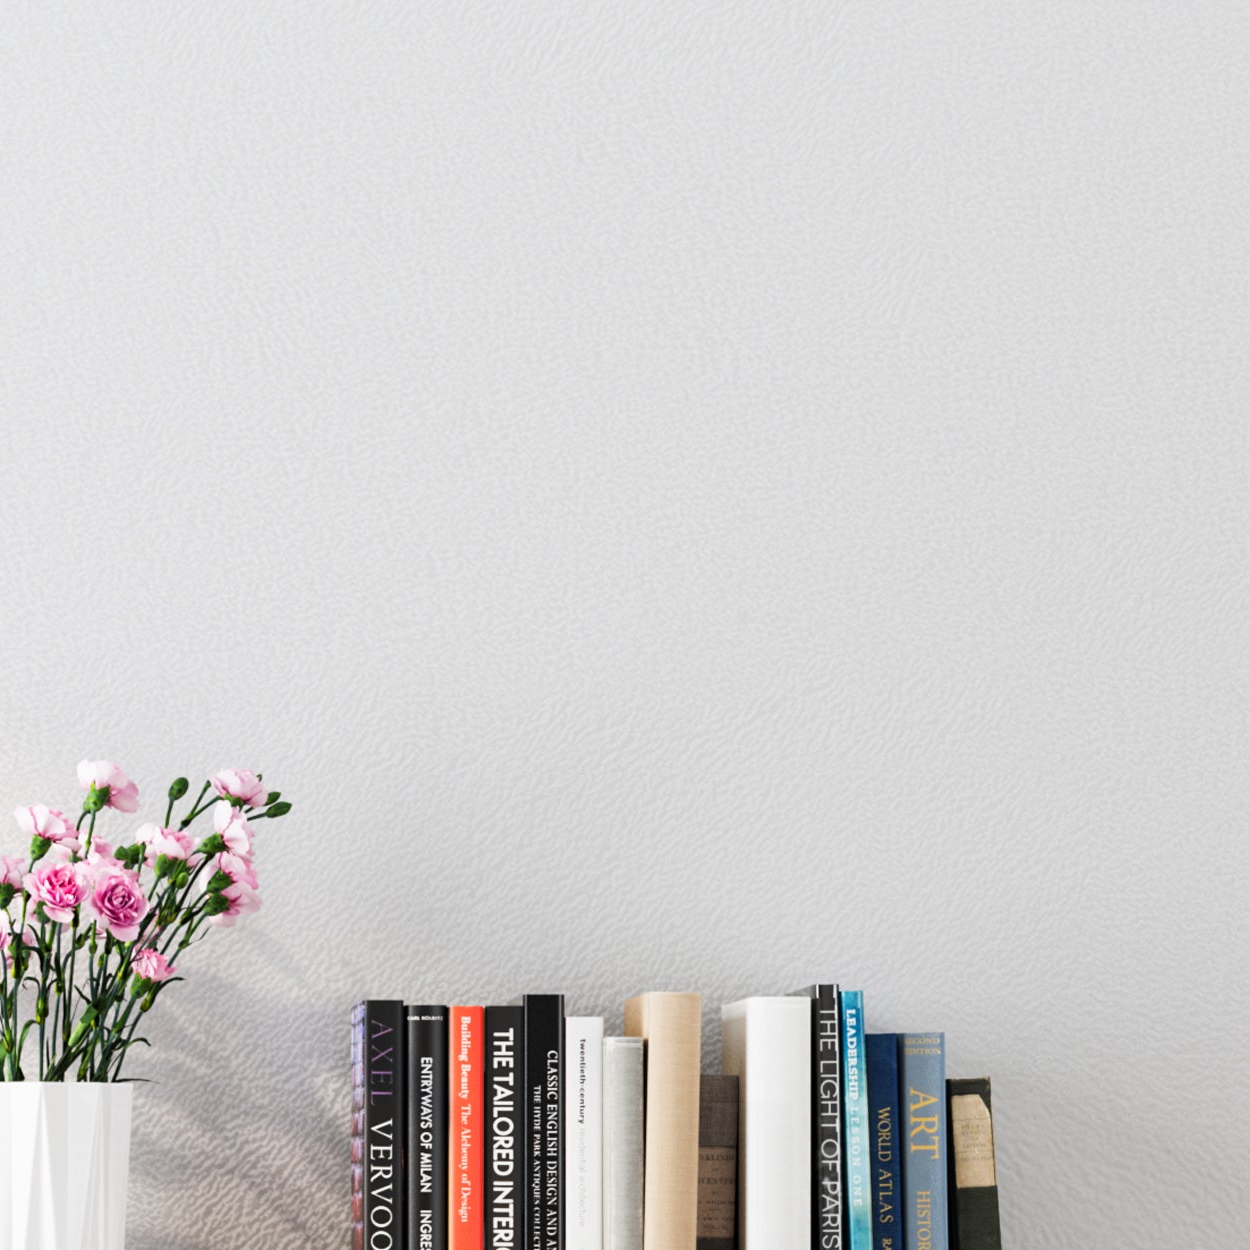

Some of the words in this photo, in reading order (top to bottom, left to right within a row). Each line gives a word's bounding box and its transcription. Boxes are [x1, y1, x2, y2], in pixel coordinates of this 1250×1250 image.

[459, 1016, 472, 1061] Building
[493, 1028, 514, 1068] THE
[819, 1007, 837, 1051] THE
[371, 1020, 393, 1106] AXEL
[546, 1050, 558, 1101] CLASSIC
[845, 1009, 858, 1100] LEADERSHIP
[420, 1057, 433, 1129] ENTRYWAYS
[458, 1064, 472, 1099] Beauty
[533, 1085, 541, 1103] THE
[577, 1039, 587, 1124] twentieth-century
[820, 1060, 838, 1132] LIGHT
[461, 1104, 472, 1124] The
[493, 1072, 514, 1175] TAILORED
[533, 1106, 541, 1130] HYDE
[546, 1104, 558, 1156] ENGLISH
[877, 1107, 892, 1161] WORLD
[909, 1088, 940, 1159] ART
[420, 1132, 433, 1149] OF
[458, 1127, 472, 1171] Alchemy
[533, 1134, 541, 1157] PARK
[578, 1128, 587, 1173] residential
[821, 1138, 839, 1171] OF
[849, 1107, 861, 1167] LESSON
[420, 1152, 433, 1192] MILAN
[461, 1174, 472, 1185] of
[532, 1160, 541, 1204] ANTIQUES
[546, 1160, 558, 1205] DESIGN
[852, 1176, 863, 1207] ONE
[458, 1187, 472, 1222] Design
[578, 1176, 587, 1226] architecture
[878, 1169, 893, 1223] ATLAS
[546, 1209, 558, 1235] AND
